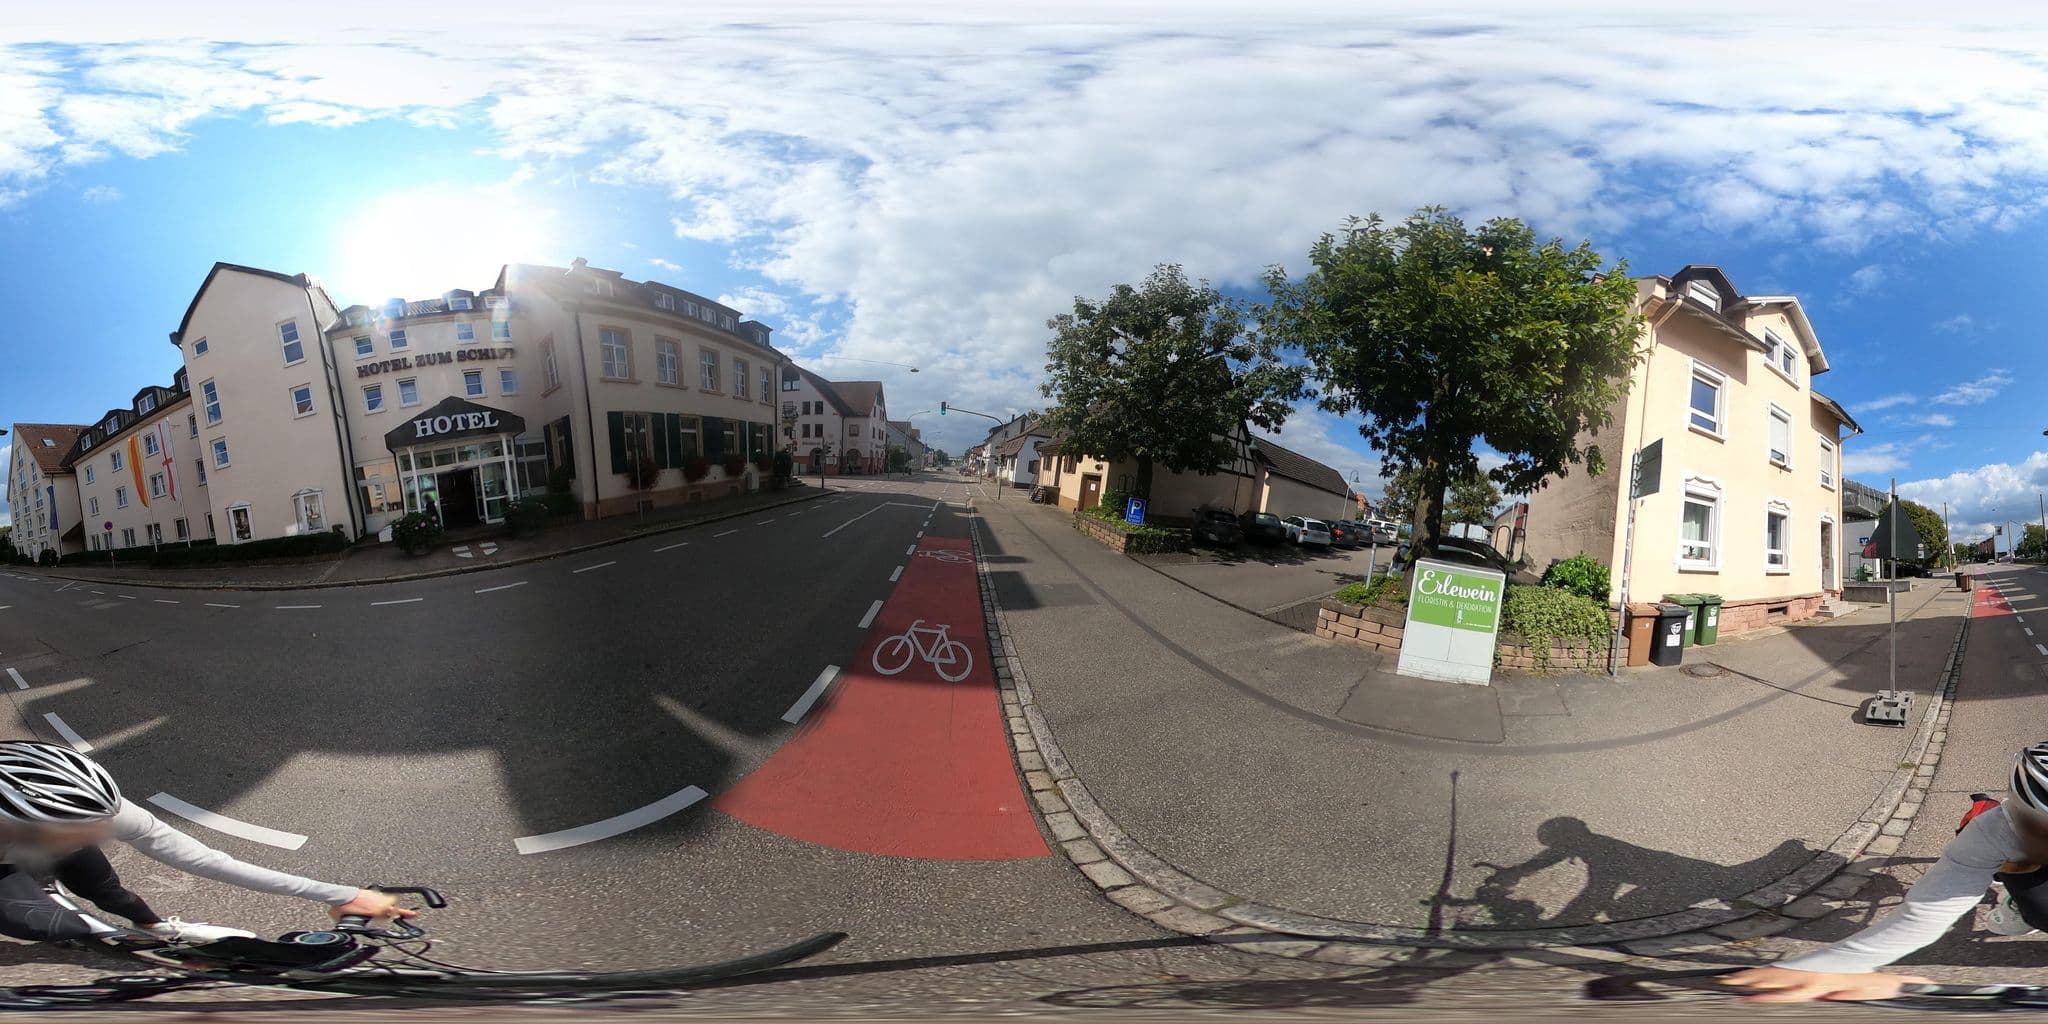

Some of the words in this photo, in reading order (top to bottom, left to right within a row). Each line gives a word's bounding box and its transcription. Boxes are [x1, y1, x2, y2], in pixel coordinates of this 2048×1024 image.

[357, 357, 412, 378] HOTEL
[415, 351, 452, 368] ZUM
[413, 411, 499, 438] HOTEL
[1418, 570, 1496, 602] Erlewein
[1418, 595, 1448, 607] FLORISTIK
